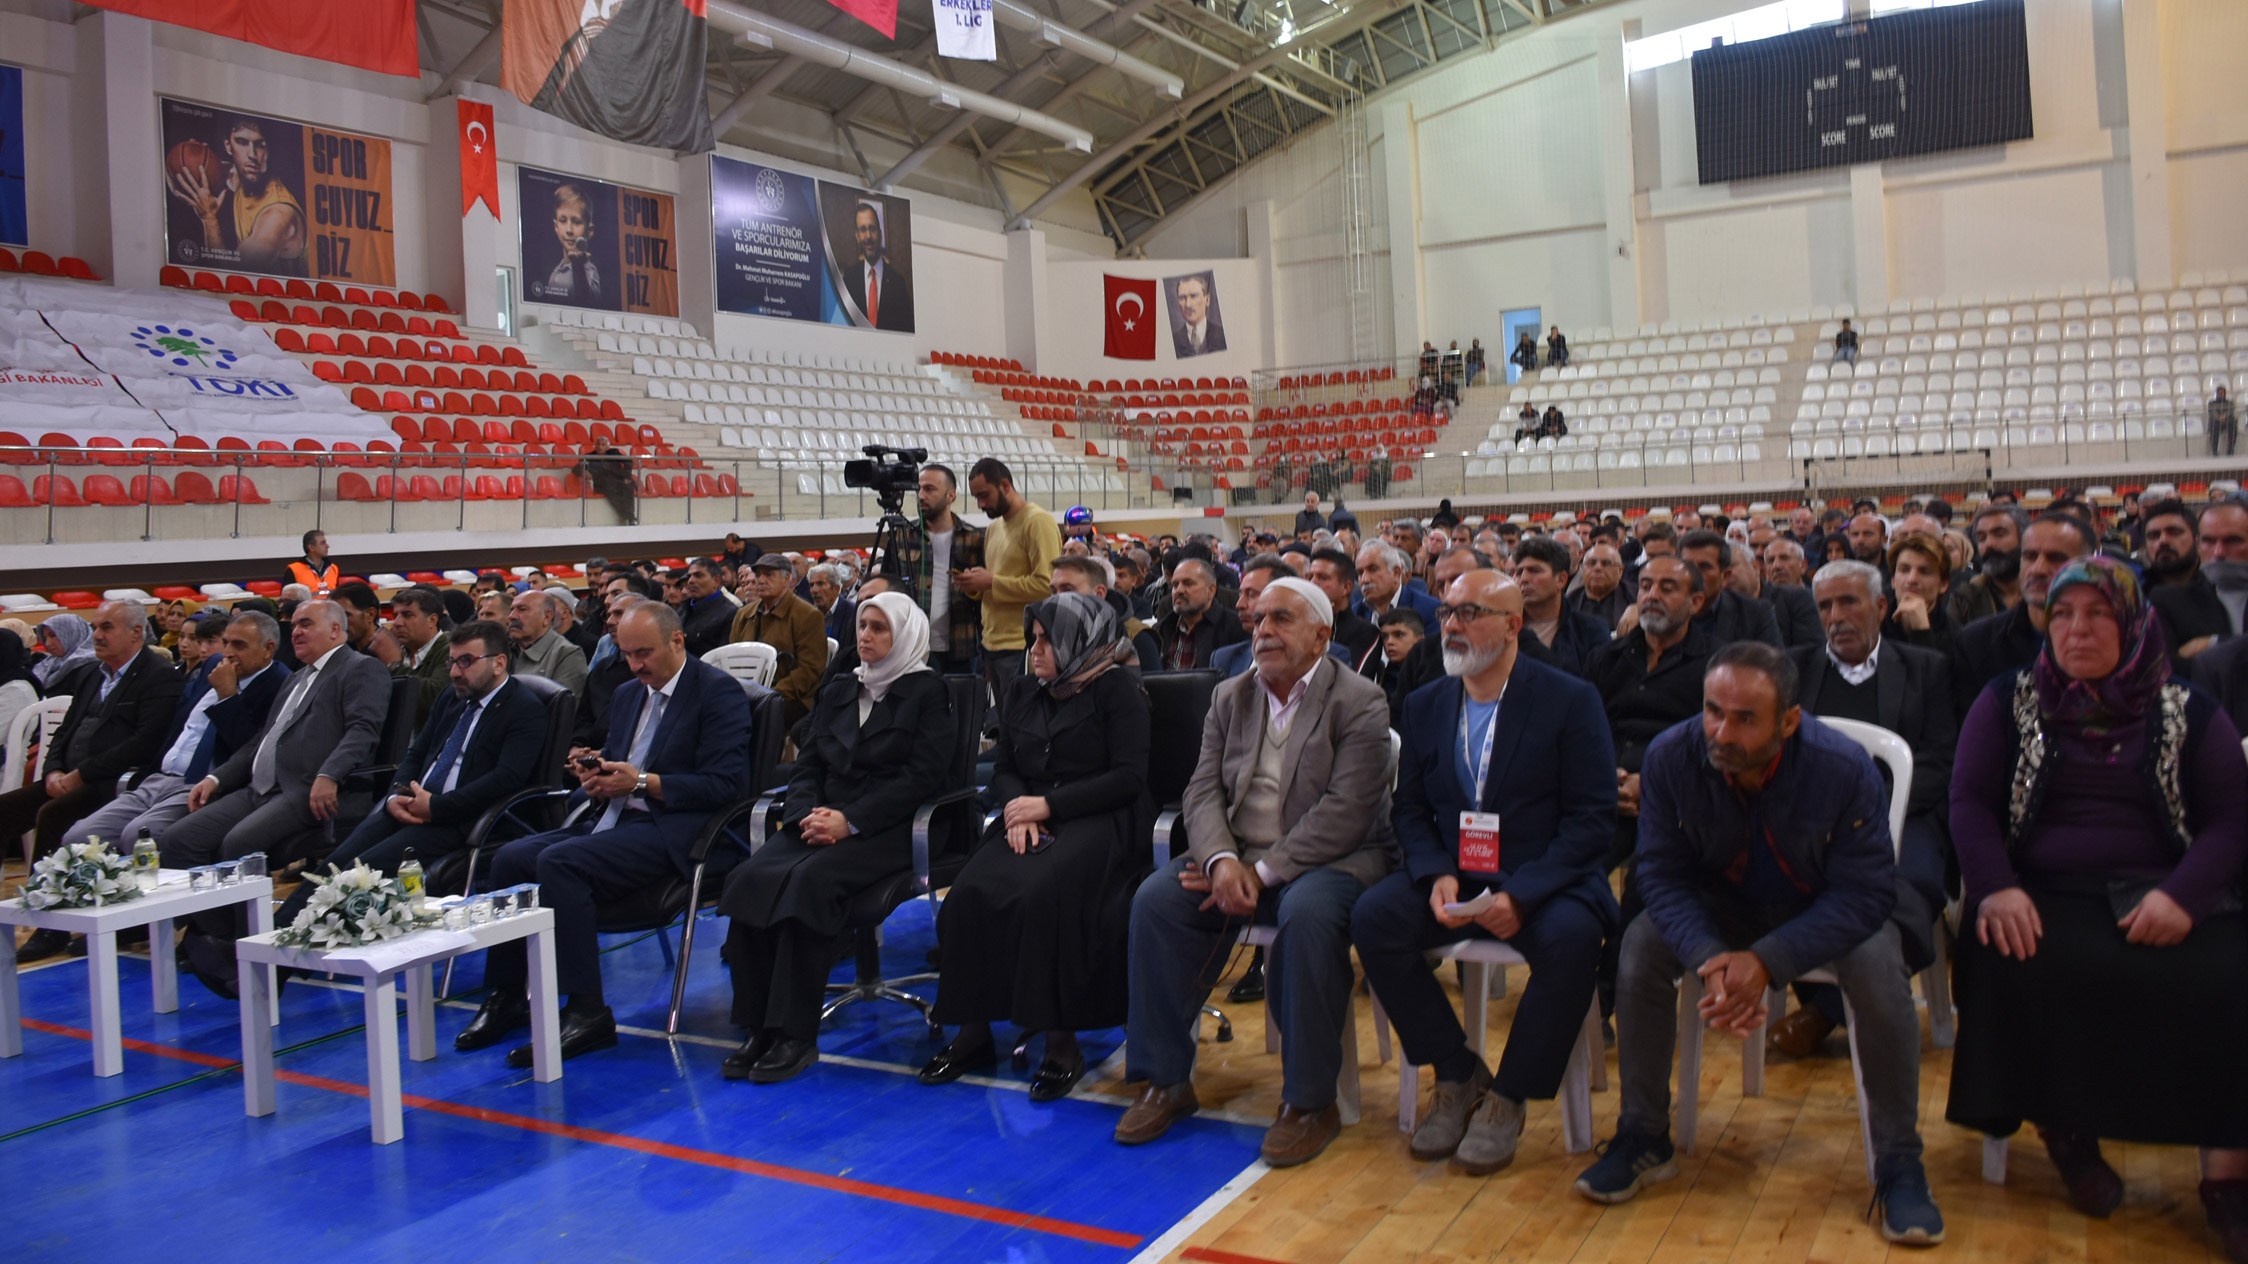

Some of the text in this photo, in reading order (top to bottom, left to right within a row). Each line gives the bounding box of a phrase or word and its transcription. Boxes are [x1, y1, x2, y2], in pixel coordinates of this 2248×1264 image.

[1821, 130, 1846, 147] SCORE
[1870, 122, 1895, 140] SCORE
[311, 131, 368, 181] SPOR
[623, 193, 660, 231] SPOR
[732, 228, 811, 252] VE SPORCULARIMIZA
[741, 218, 803, 240] TÜM ANTRENÖR
[735, 242, 809, 263] BAŞARILAR DİLİYORUM
